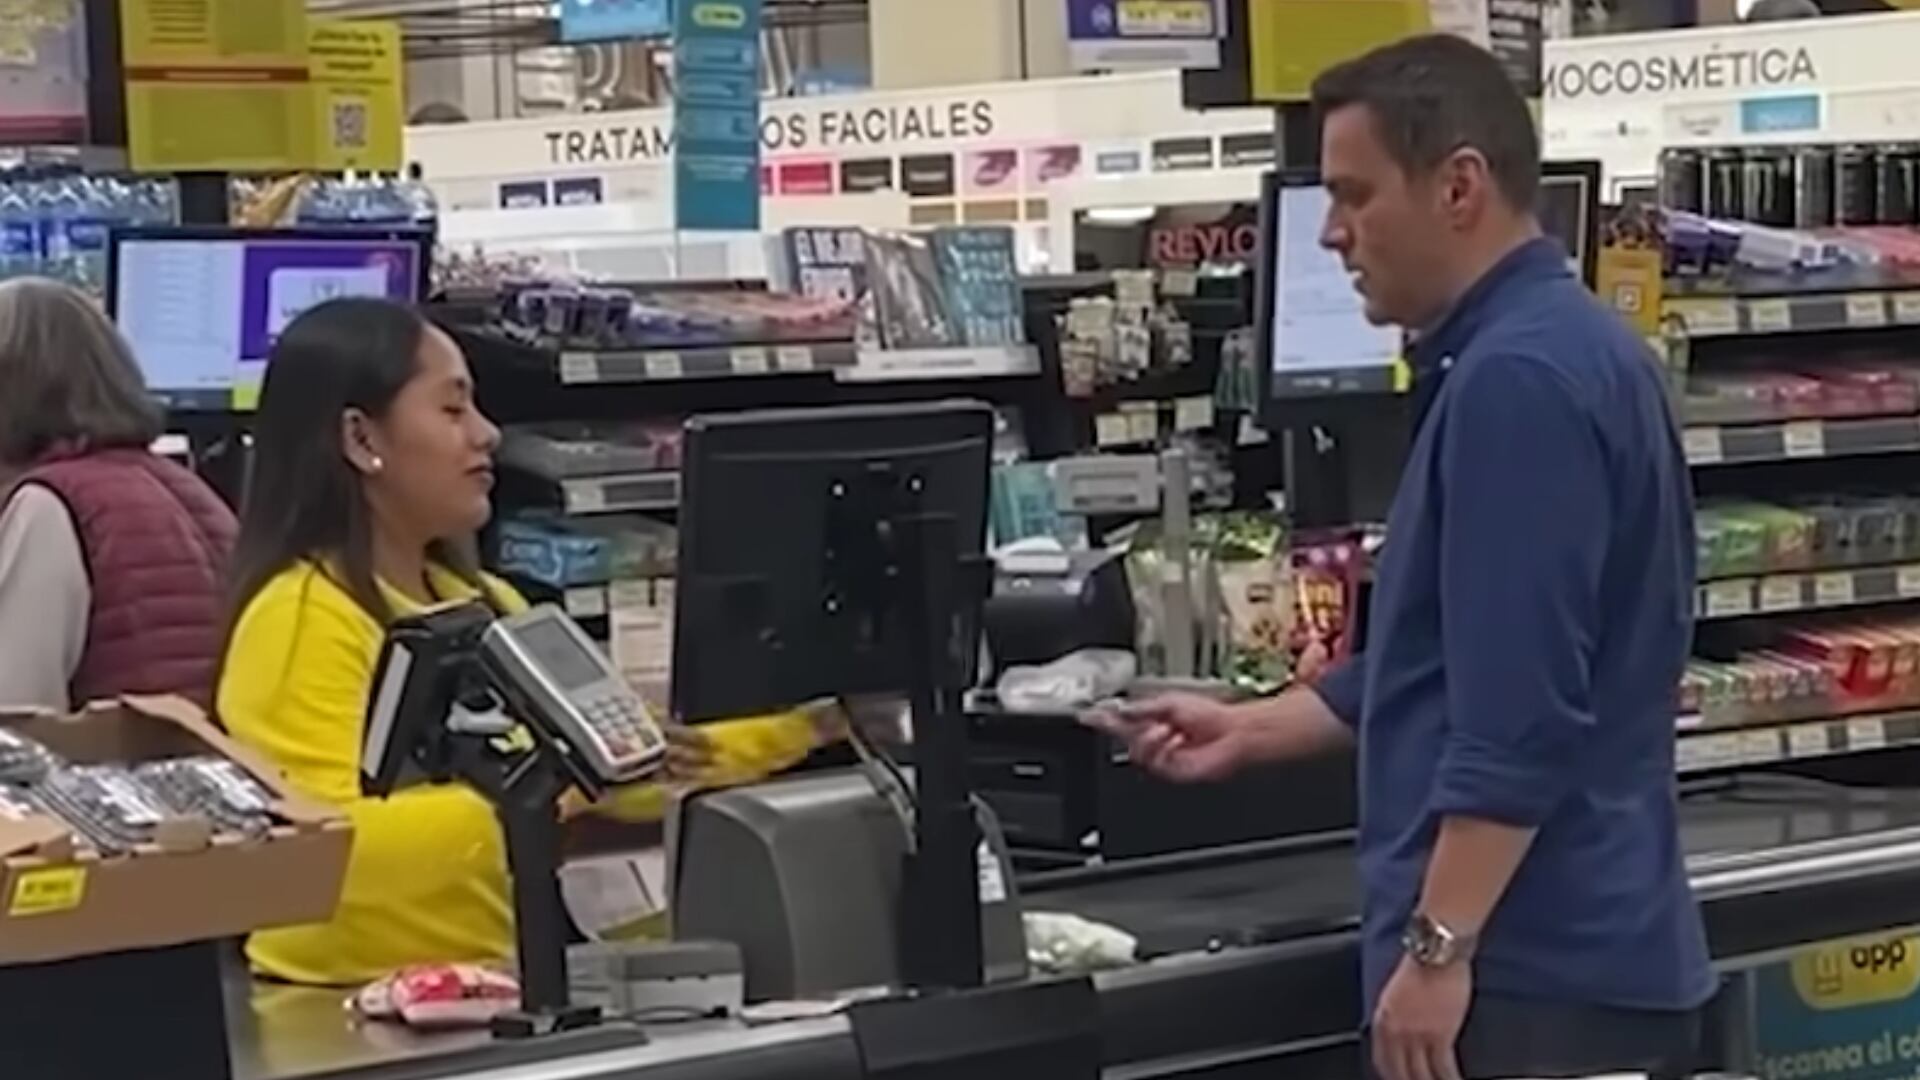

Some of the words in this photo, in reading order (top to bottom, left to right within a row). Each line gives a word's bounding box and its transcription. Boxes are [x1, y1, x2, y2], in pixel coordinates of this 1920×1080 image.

[820, 100, 992, 147] FACIALES
[1850, 938, 1907, 975] app
[1868, 1030, 1894, 1065] el
